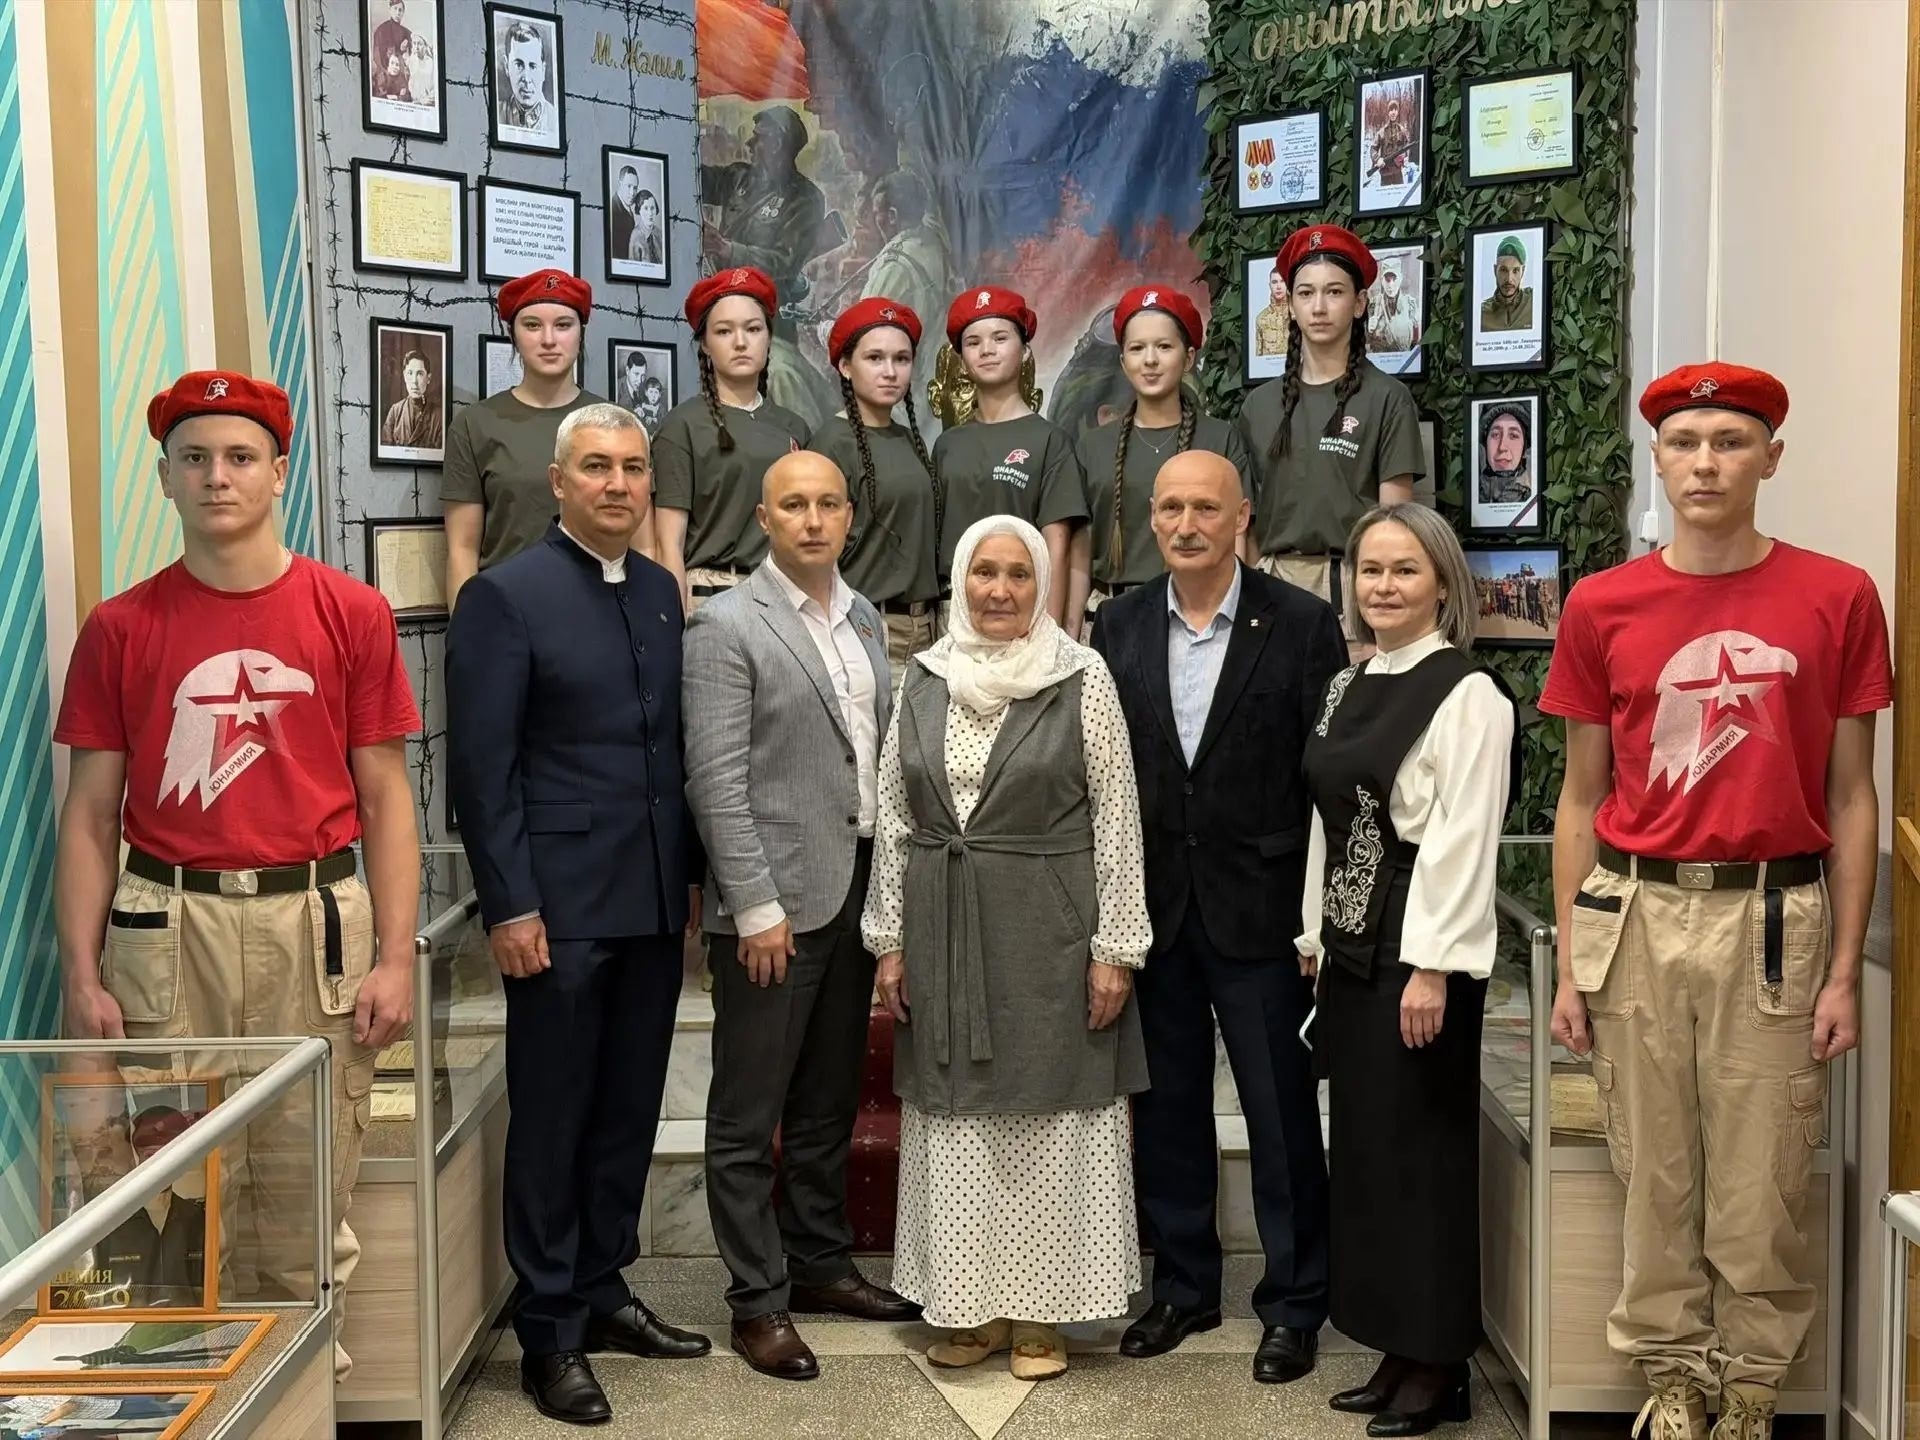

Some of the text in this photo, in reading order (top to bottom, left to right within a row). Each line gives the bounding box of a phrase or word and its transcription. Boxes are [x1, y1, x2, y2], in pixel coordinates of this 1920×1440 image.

[1319, 444, 1357, 459] ТАТАРСТАН
[1320, 436, 1359, 452] ЮНАРМИЯ
[992, 473, 1027, 489] ТАТАРСТАН
[993, 465, 1030, 482] ЮНАРМИЯ
[1692, 729, 1739, 778] ЮНАРМИЯ
[209, 746, 257, 794] ЮНАРМИЯ
